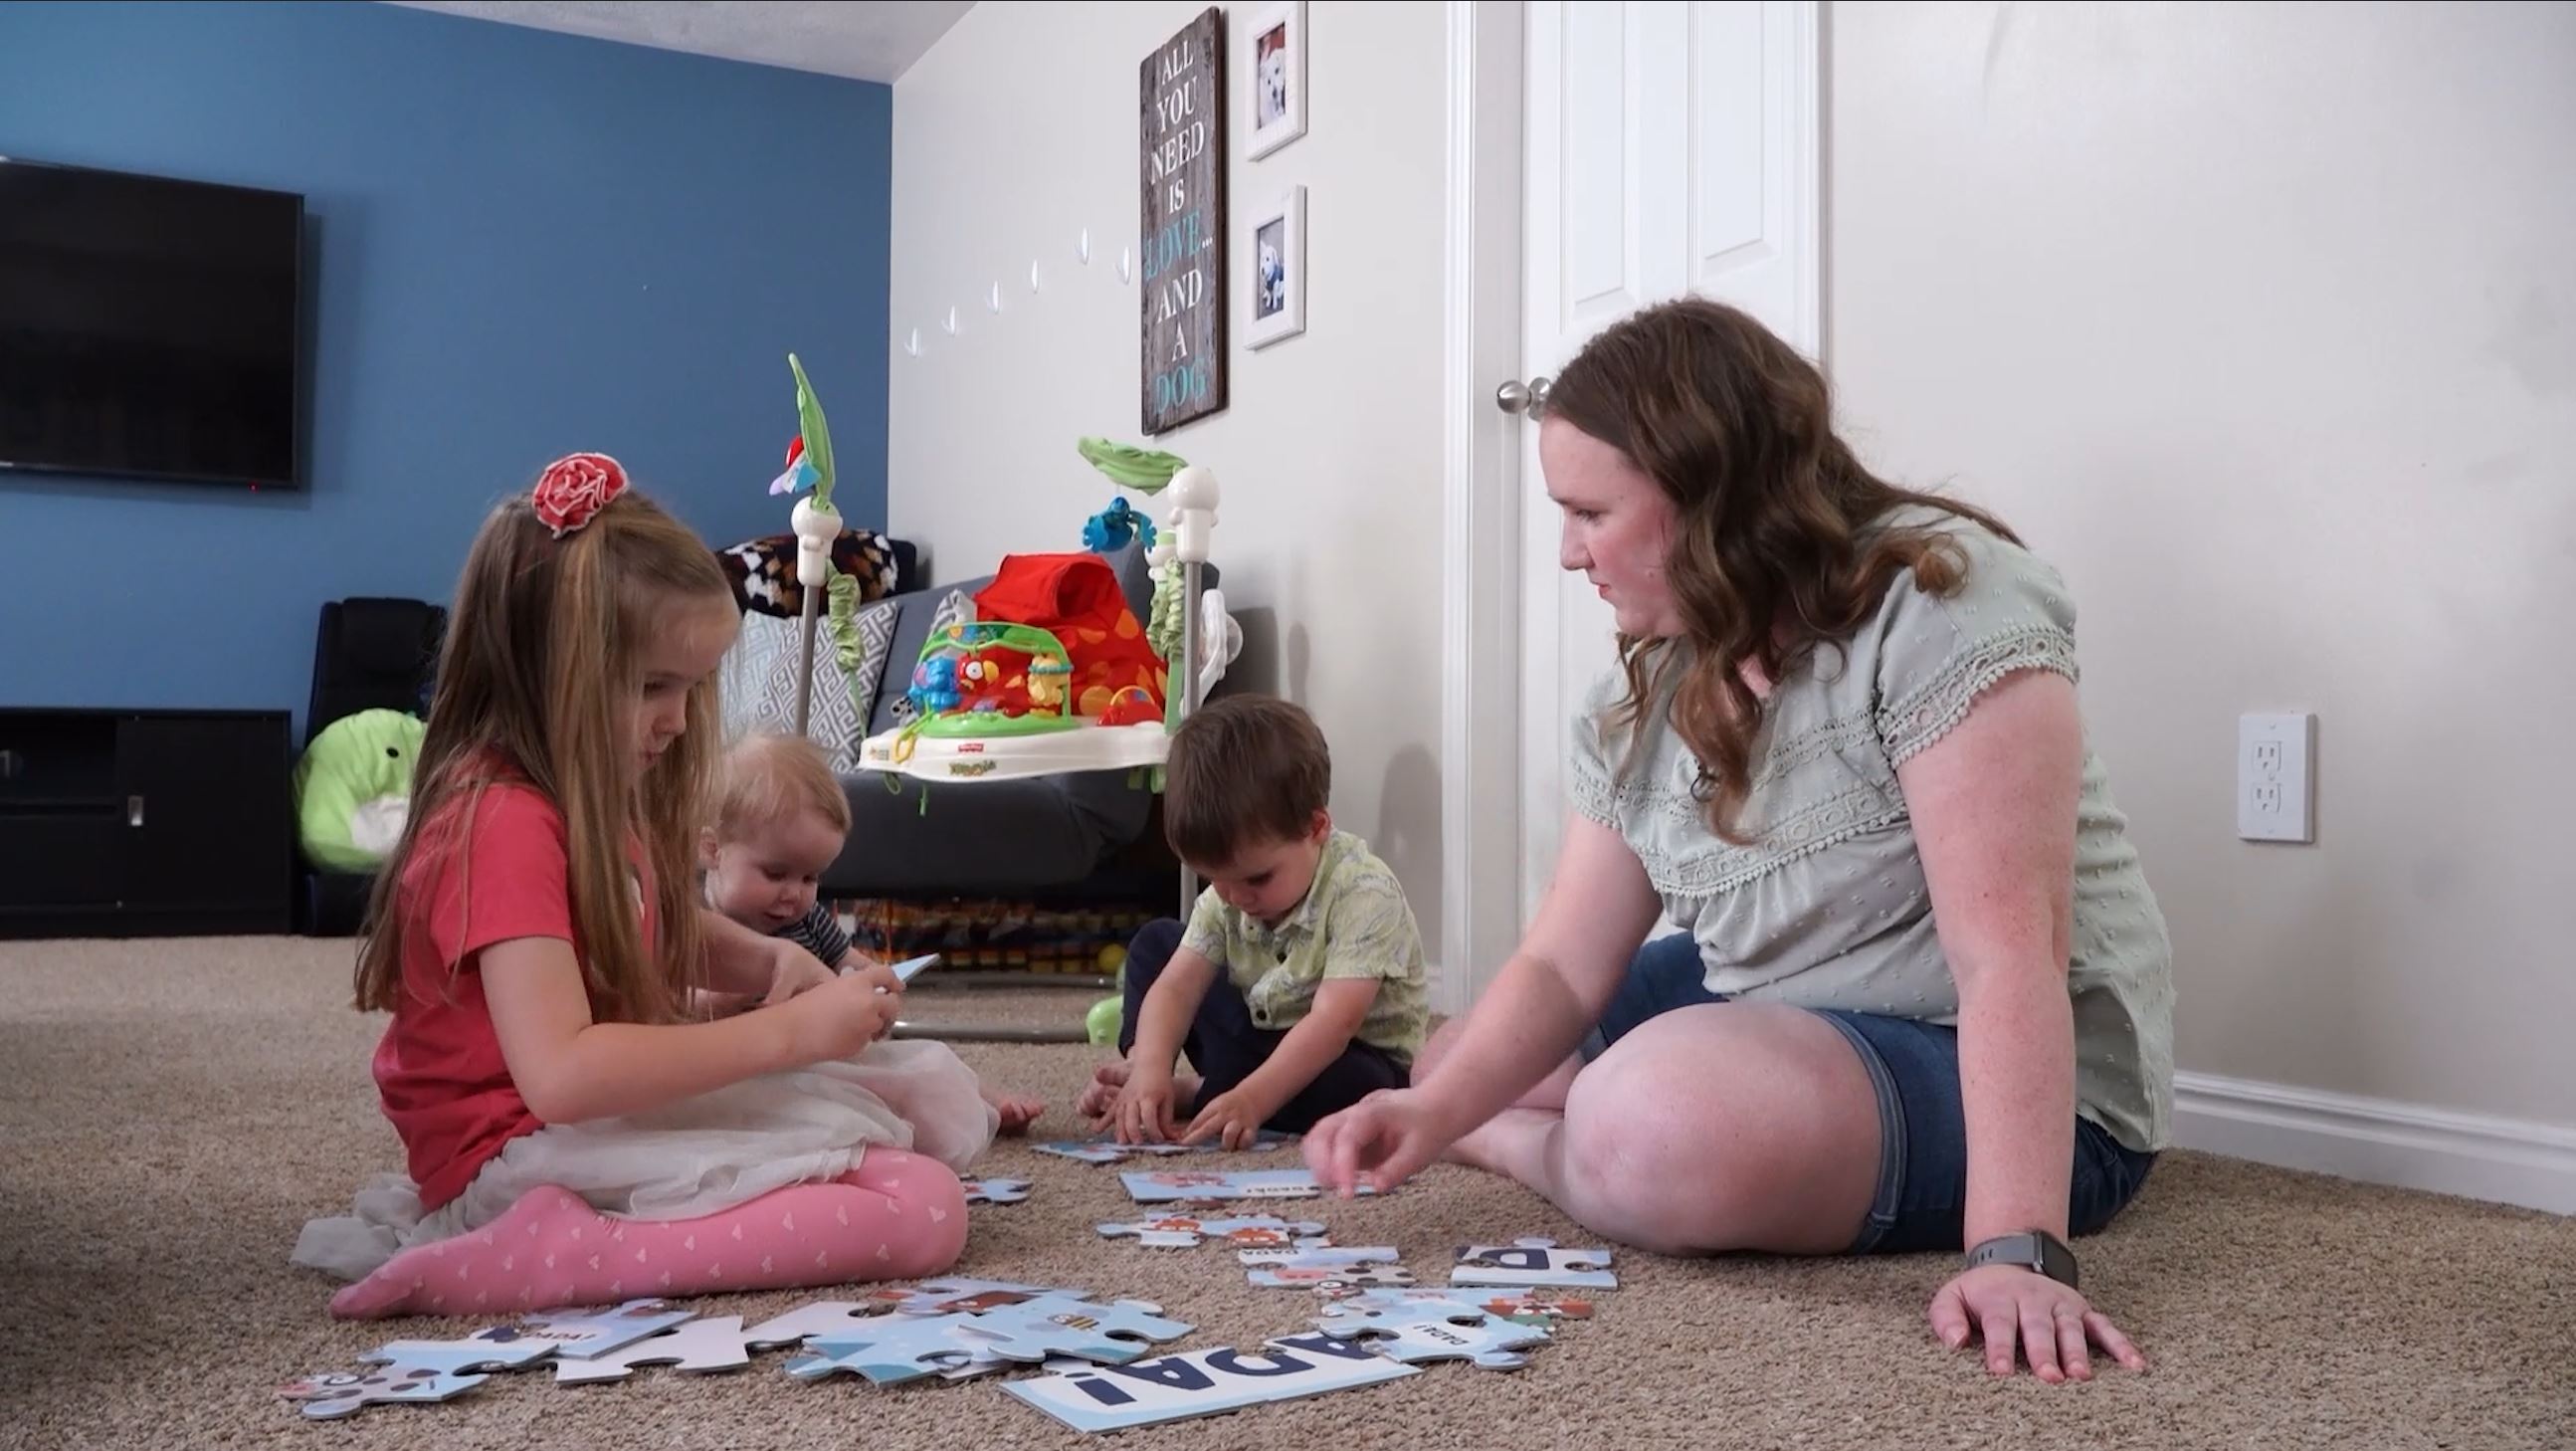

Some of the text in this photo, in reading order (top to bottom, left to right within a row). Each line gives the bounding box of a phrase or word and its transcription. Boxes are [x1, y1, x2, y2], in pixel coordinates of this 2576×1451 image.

[1160, 38, 1194, 88] ALL
[1156, 75, 1200, 133] YOU
[1150, 120, 1205, 186] NEED
[1168, 178, 1185, 215] IS
[1144, 209, 1213, 283] LOVE...
[1156, 268, 1203, 324] AND
[1171, 320, 1187, 363] A
[1153, 355, 1208, 416] DOG
